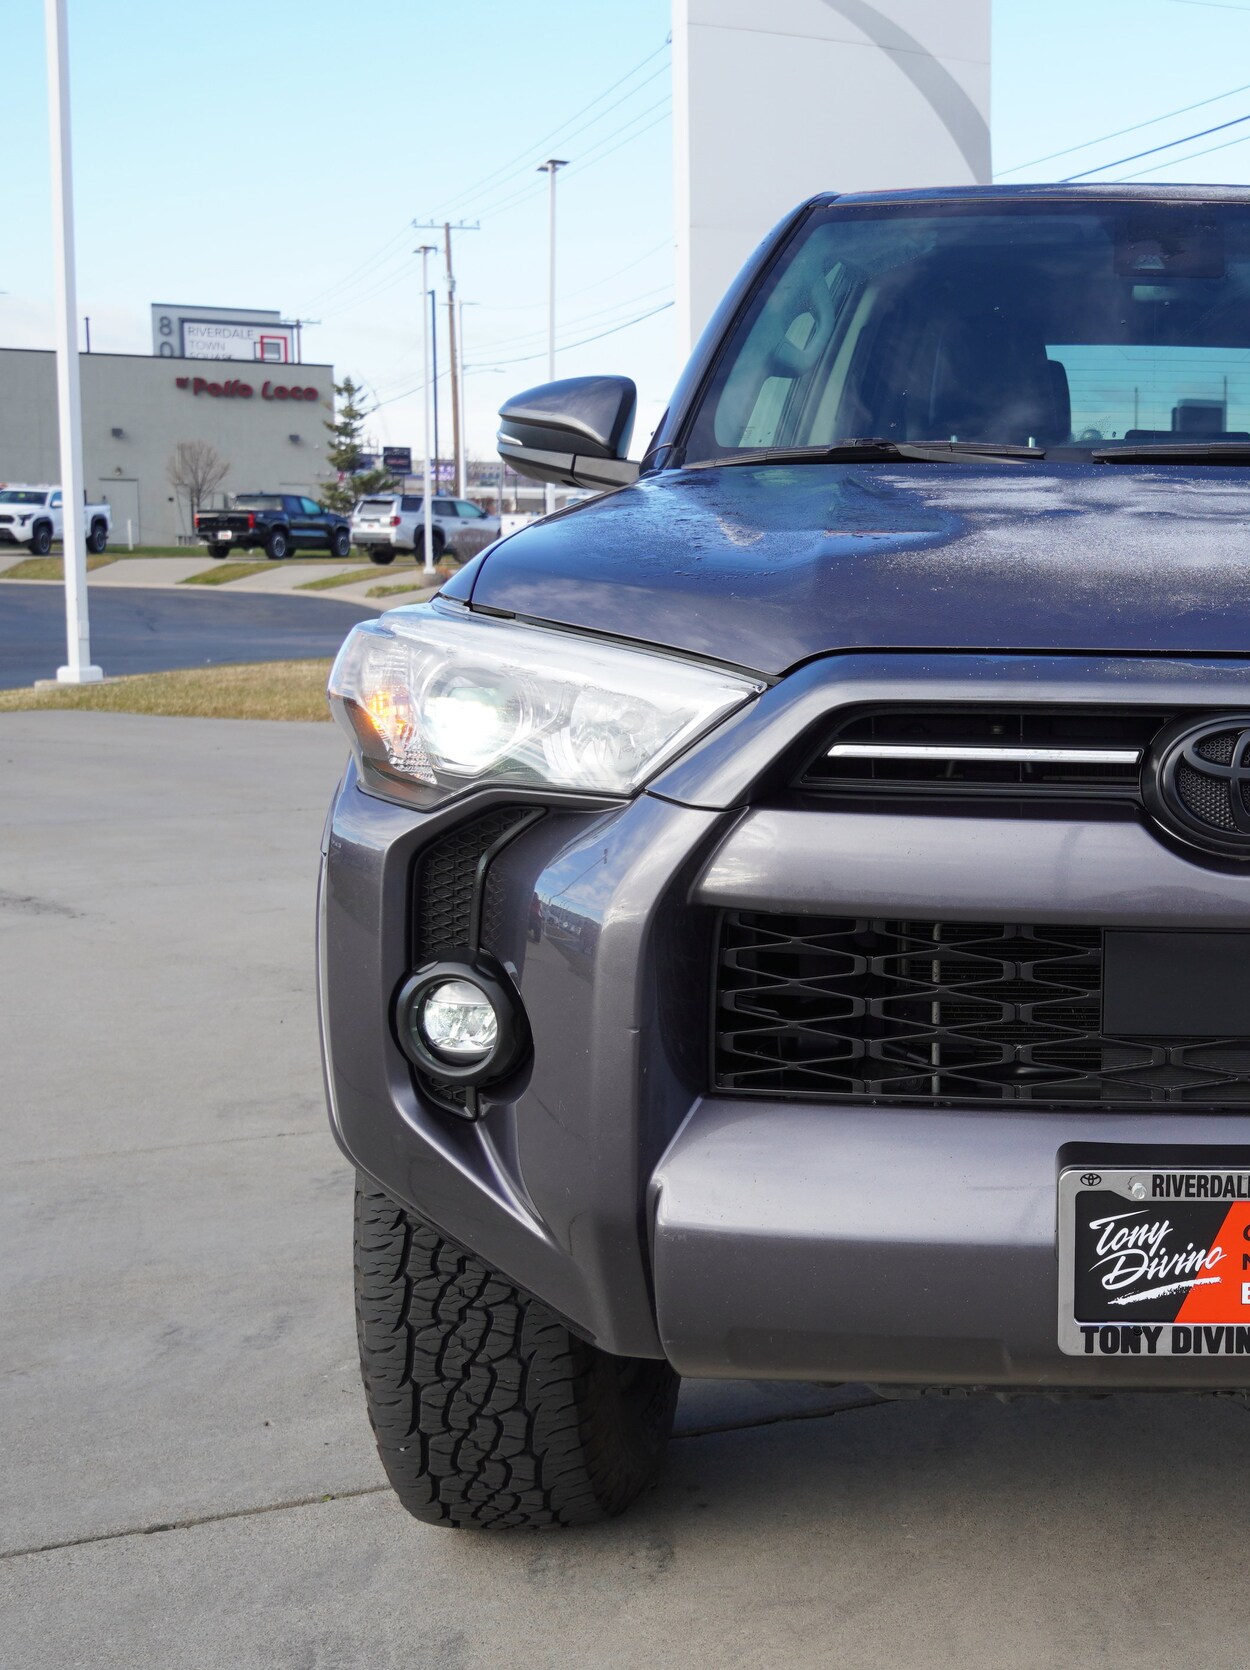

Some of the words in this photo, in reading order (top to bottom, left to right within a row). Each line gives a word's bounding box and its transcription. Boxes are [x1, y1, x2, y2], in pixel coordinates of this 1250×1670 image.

[187, 326, 254, 340] RIVERDALE
[189, 339, 226, 351] TOWN
[193, 377, 254, 398] Pollo
[261, 381, 319, 401] Loco
[1088, 1209, 1173, 1257] Tony
[1088, 1242, 1227, 1290] Divino
[1080, 1326, 1167, 1354] TONY
